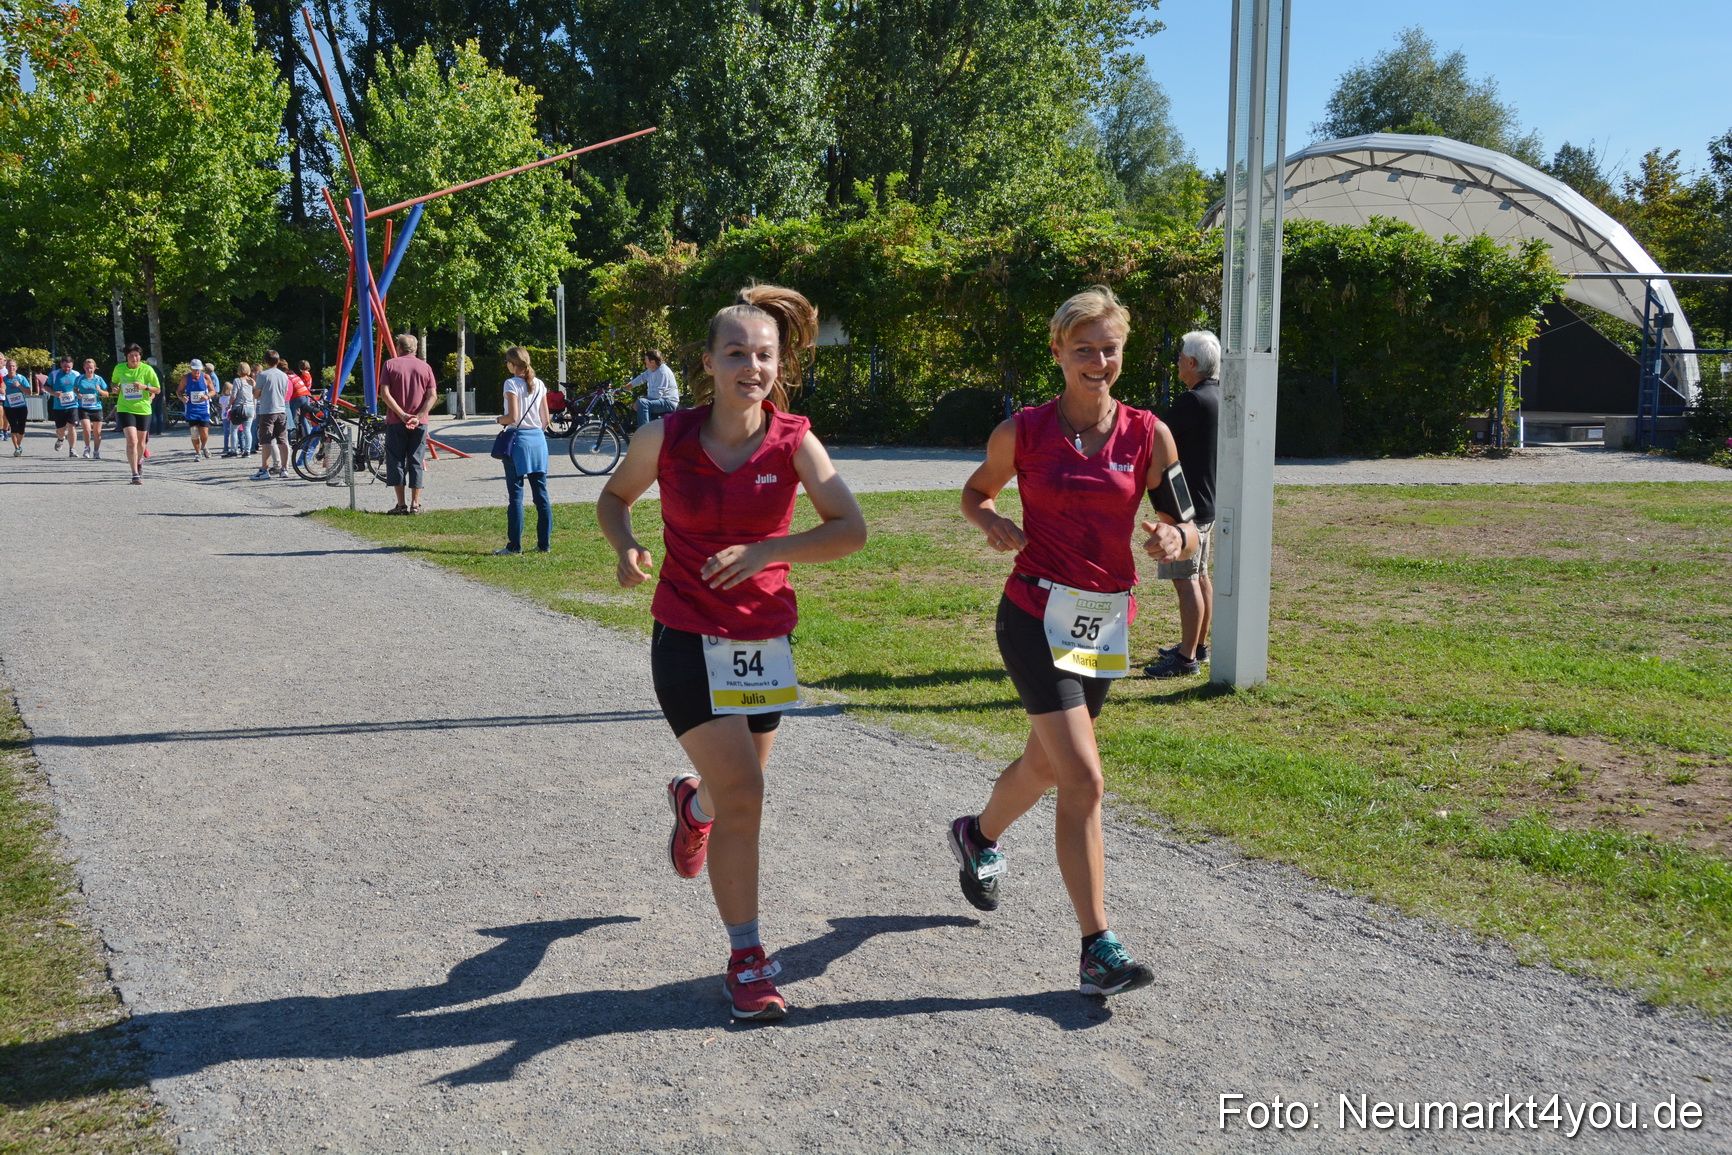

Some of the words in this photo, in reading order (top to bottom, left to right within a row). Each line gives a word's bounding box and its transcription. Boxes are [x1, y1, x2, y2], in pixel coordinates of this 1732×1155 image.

[1109, 461, 1134, 472] Maria
[755, 473, 778, 484] Julia
[1076, 599, 1112, 611] BOCK
[1070, 615, 1103, 641] 55
[733, 650, 764, 677] 54
[1072, 653, 1098, 668] Maria
[741, 693, 766, 705] Julia
